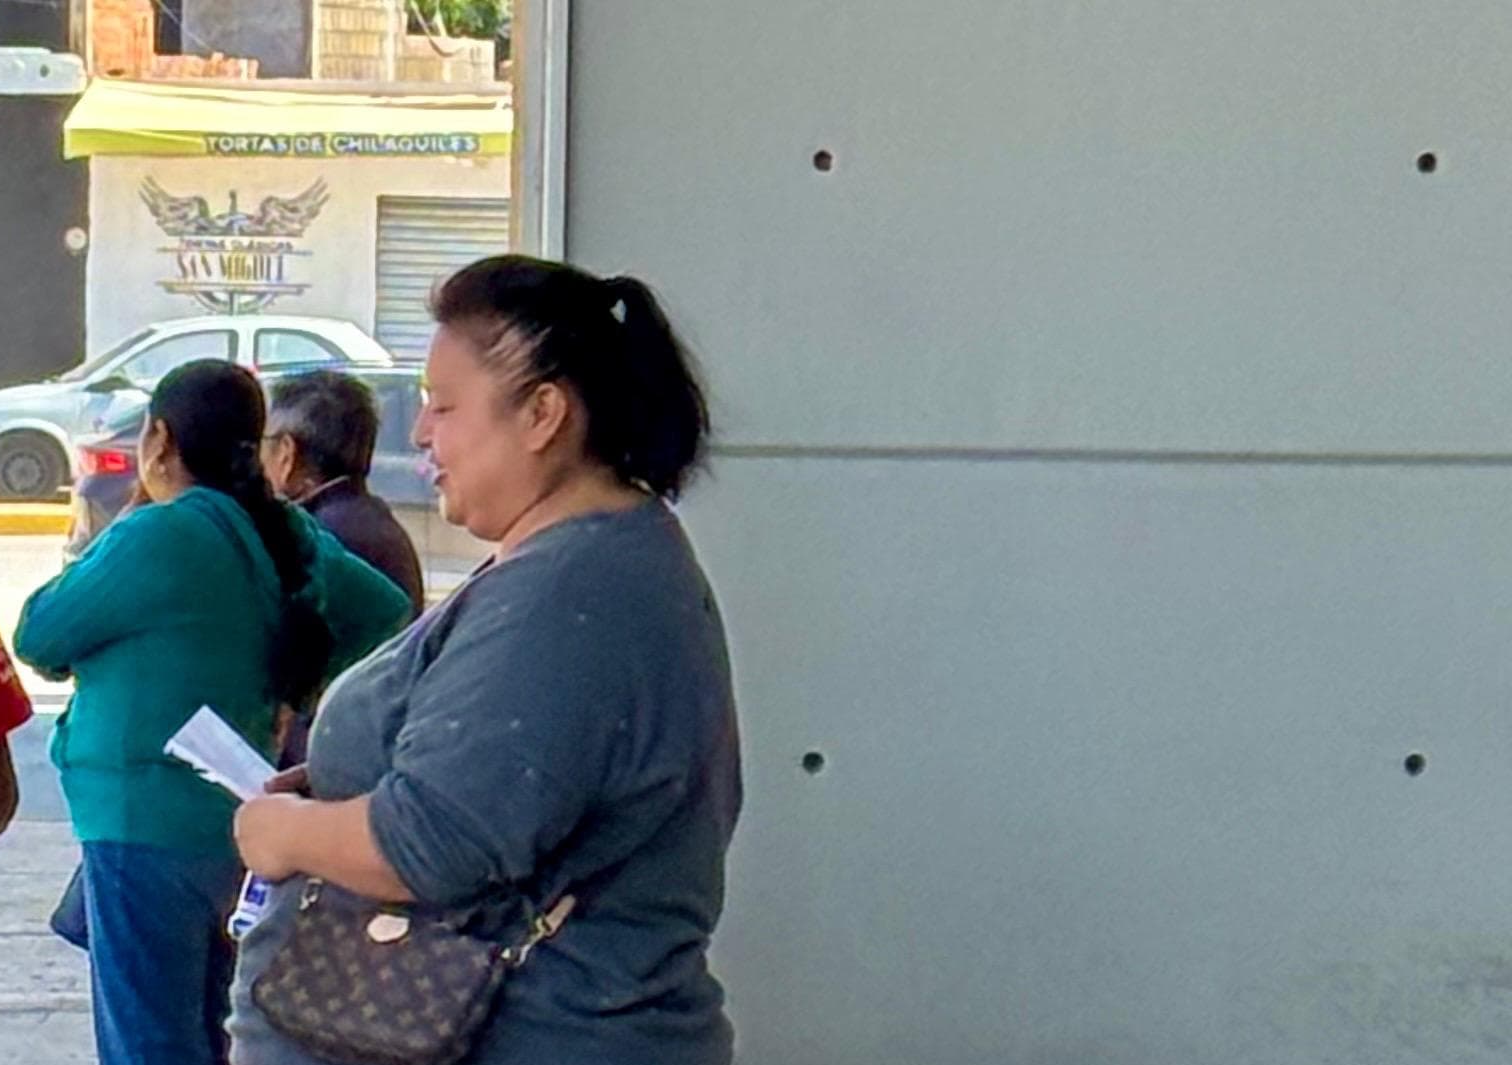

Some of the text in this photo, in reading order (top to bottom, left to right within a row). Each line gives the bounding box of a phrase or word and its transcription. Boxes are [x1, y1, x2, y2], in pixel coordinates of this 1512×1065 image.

[206, 135, 478, 152] TORTAS DE CHILAQUILES
